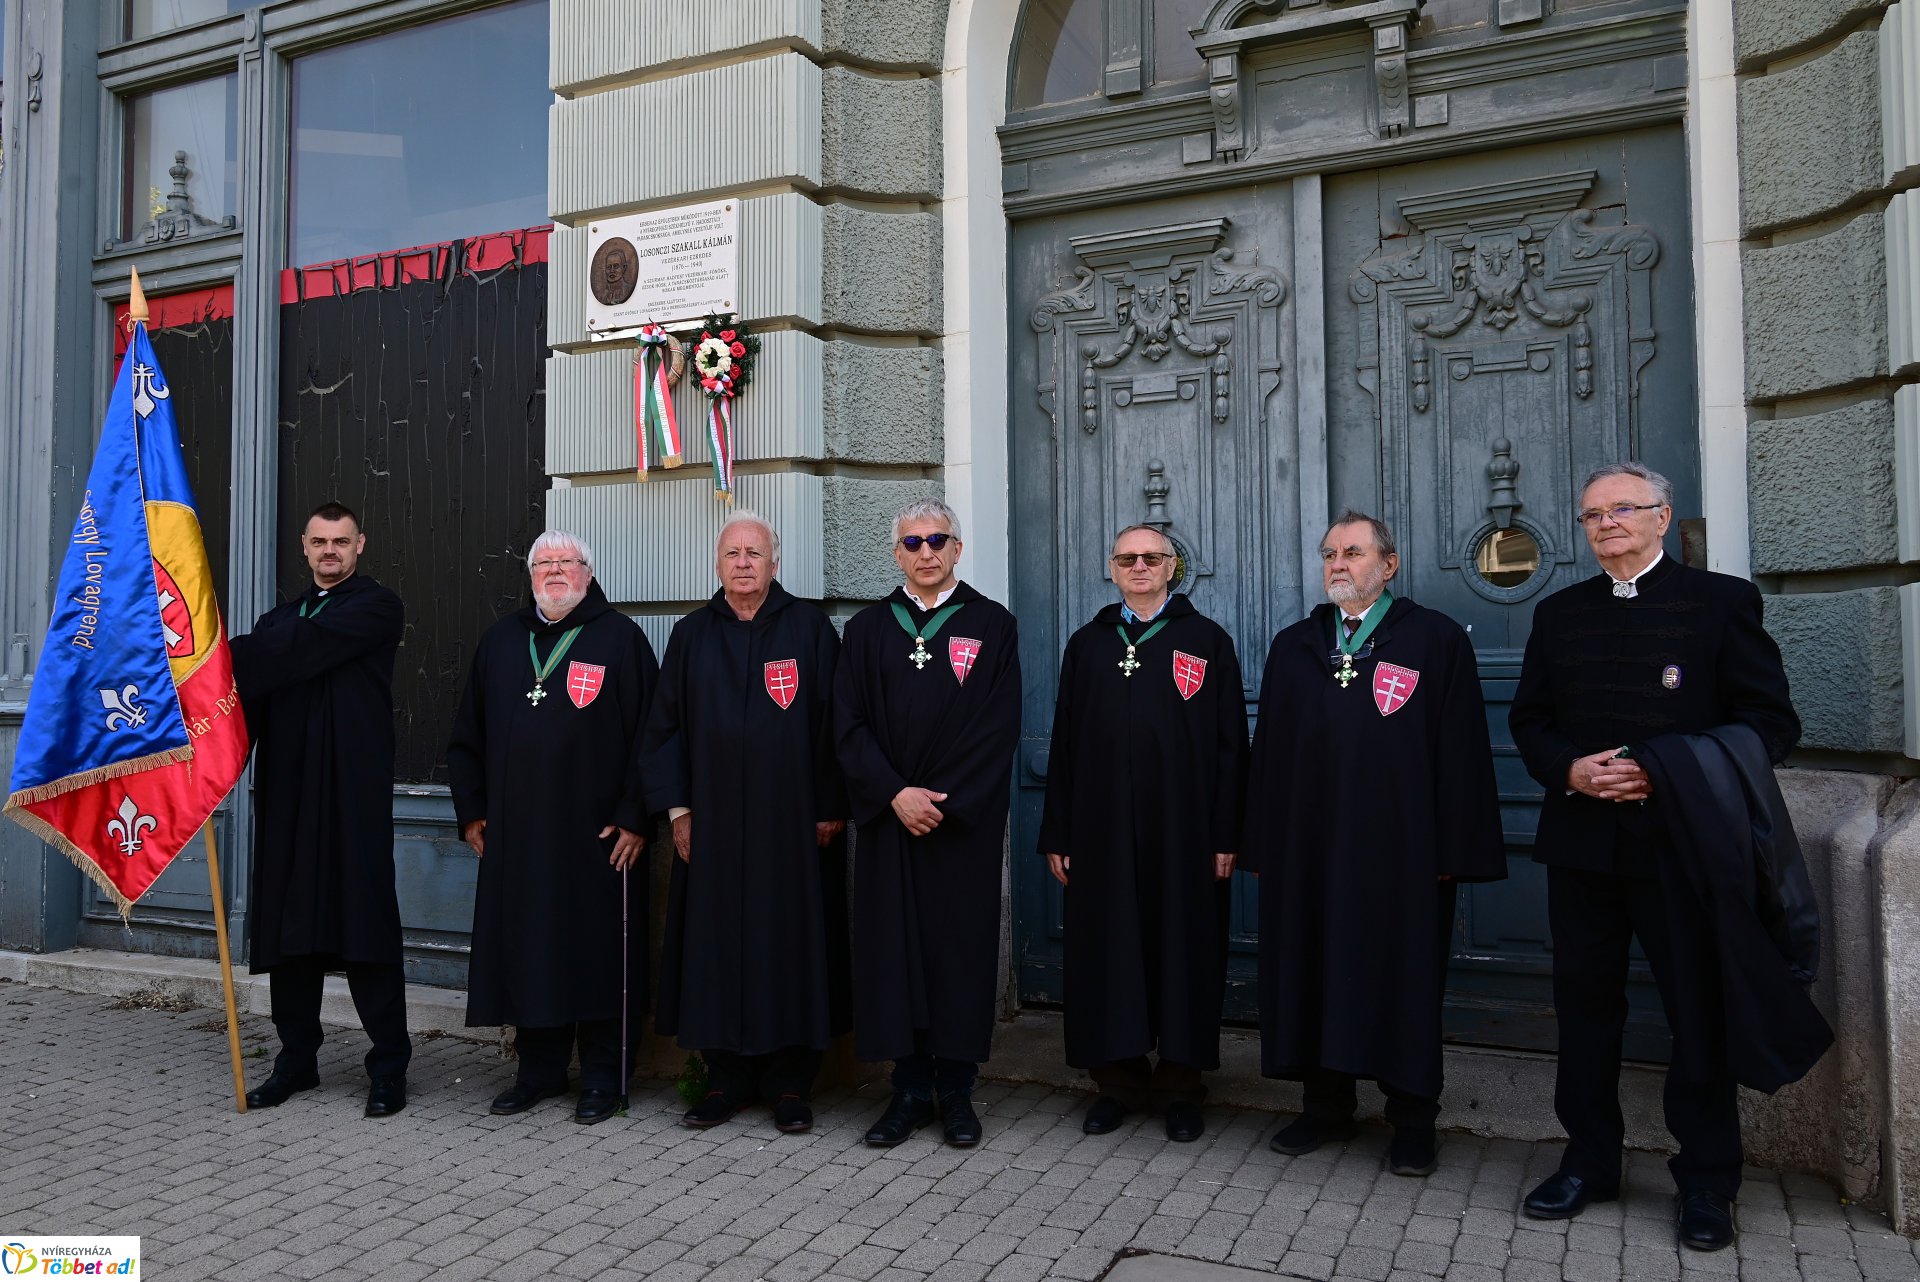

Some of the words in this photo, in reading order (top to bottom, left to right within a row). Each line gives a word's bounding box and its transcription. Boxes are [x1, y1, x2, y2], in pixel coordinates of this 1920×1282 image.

[641, 246, 669, 258] LOSONCZI
[671, 240, 701, 253] SZAKALL
[703, 234, 732, 248] KÁLMÁN
[72, 551, 109, 651] Lovagrend
